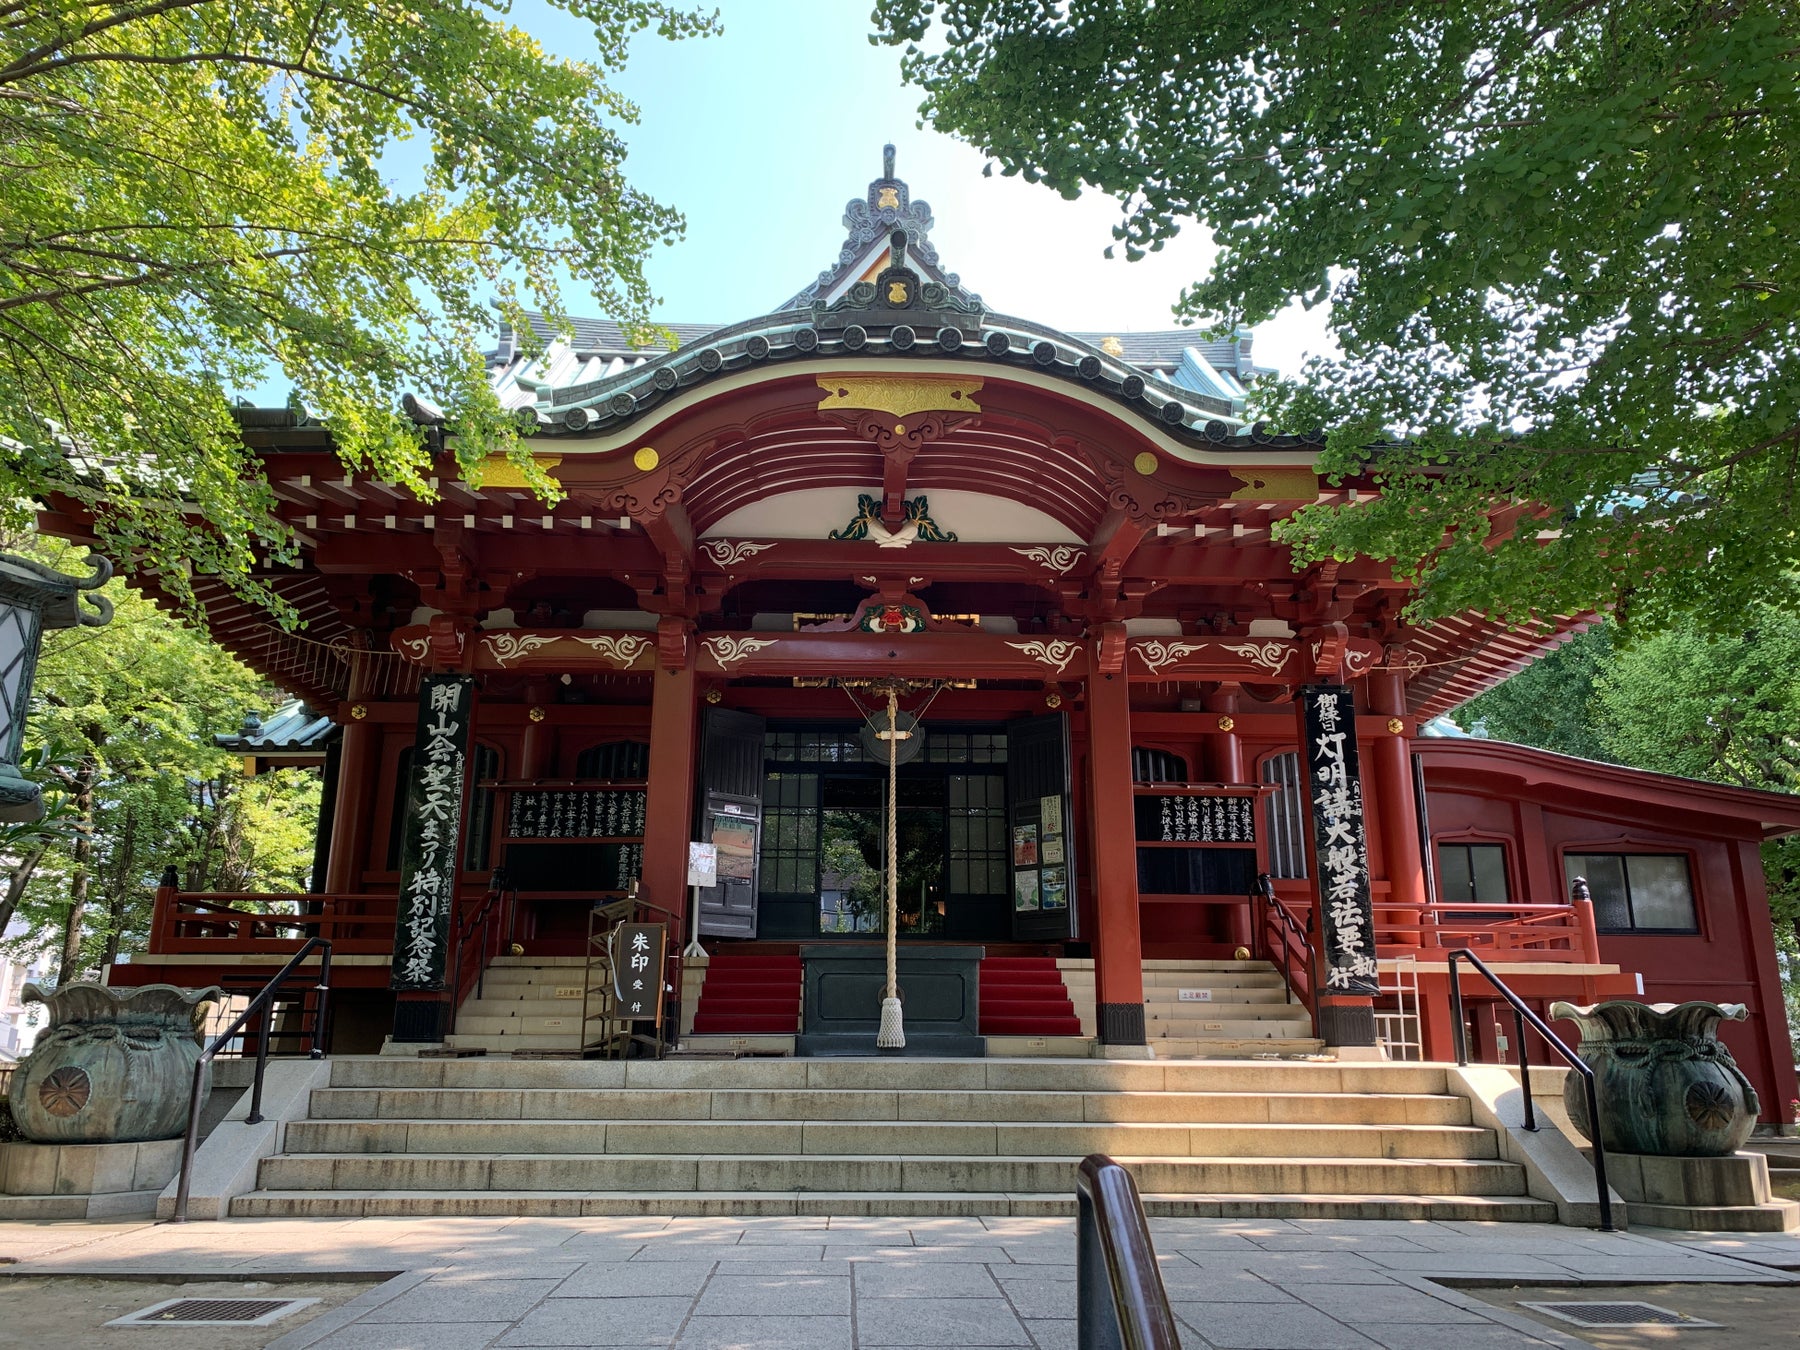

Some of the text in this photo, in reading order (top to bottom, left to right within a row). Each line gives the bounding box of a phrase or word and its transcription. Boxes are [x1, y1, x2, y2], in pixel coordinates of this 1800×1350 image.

[631, 932, 650, 1013] 朱印受付
[1183, 992, 1208, 1000] 土足厳禁
